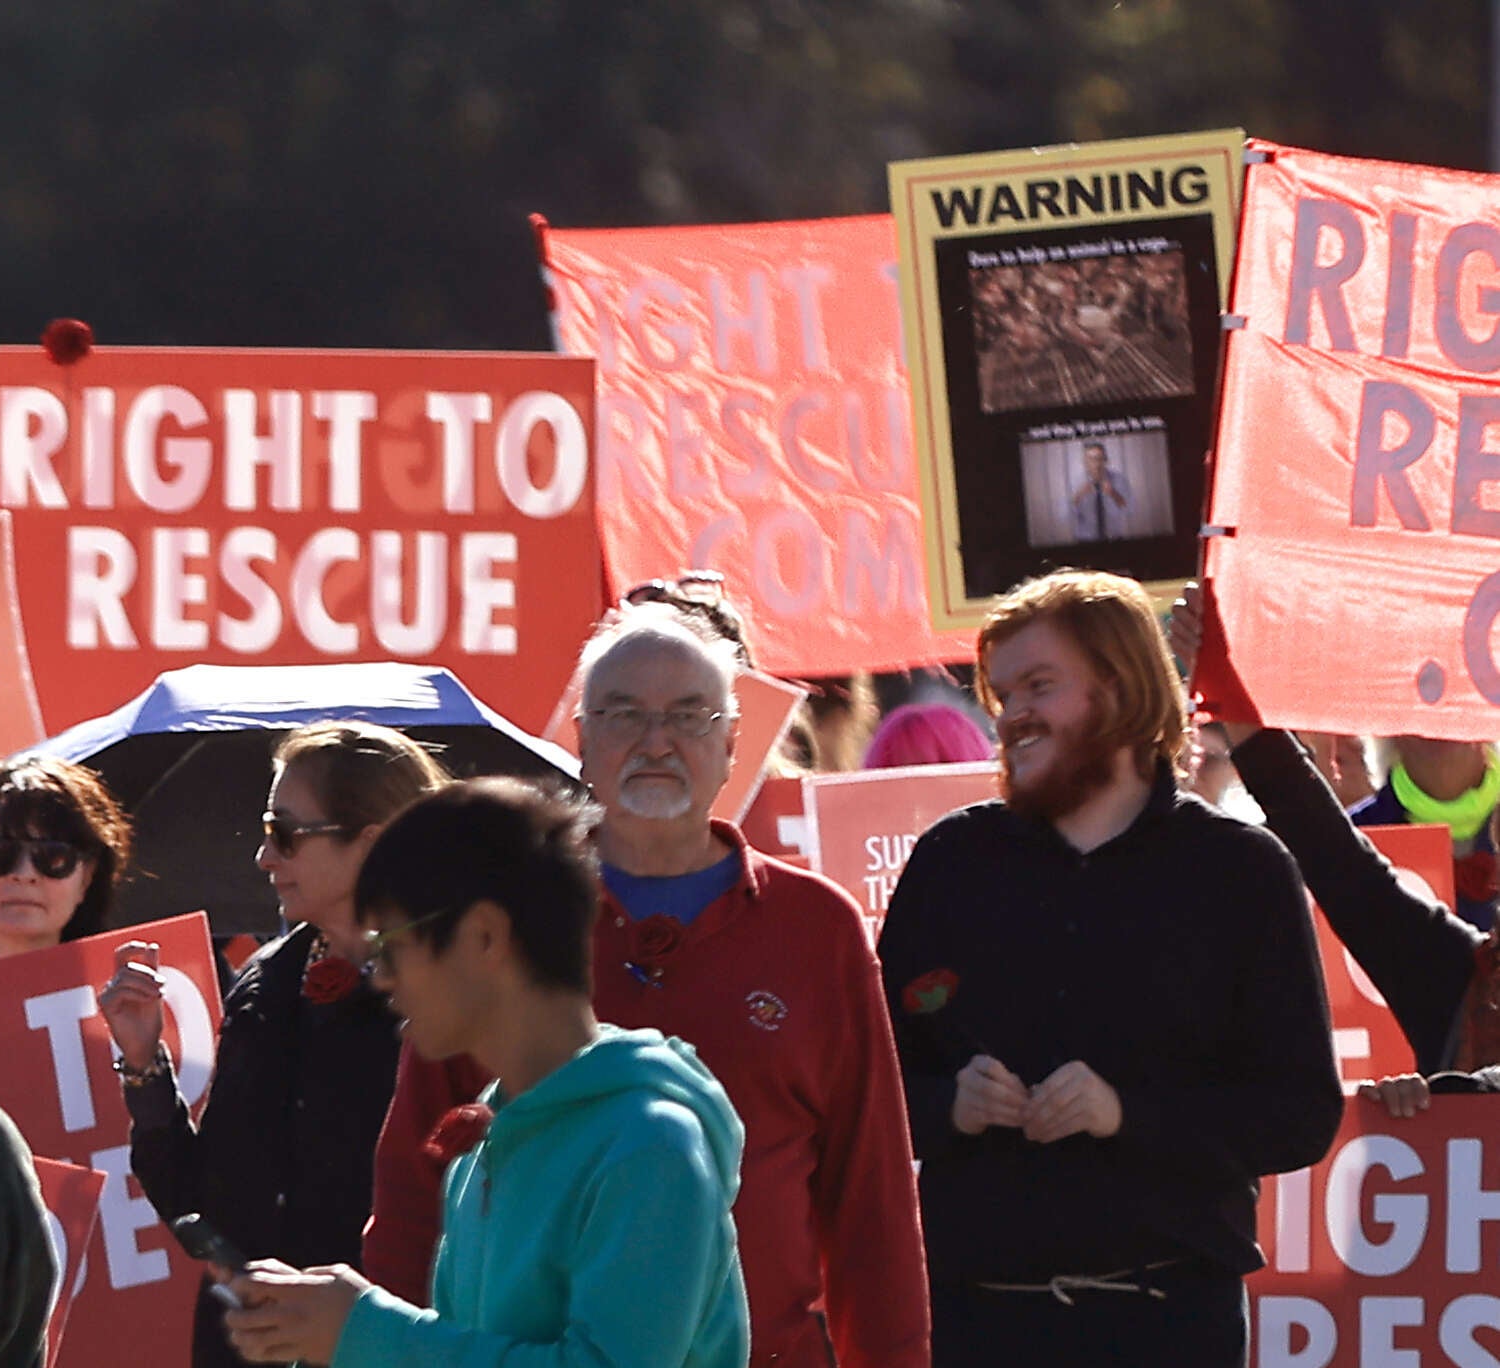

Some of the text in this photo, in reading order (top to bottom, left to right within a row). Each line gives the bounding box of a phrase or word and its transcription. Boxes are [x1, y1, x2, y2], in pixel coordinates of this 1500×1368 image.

[930, 166, 1210, 228] WARNING
[1281, 197, 1500, 374] RIG
[424, 390, 591, 519] TO
[66, 525, 519, 656] RESCUE
